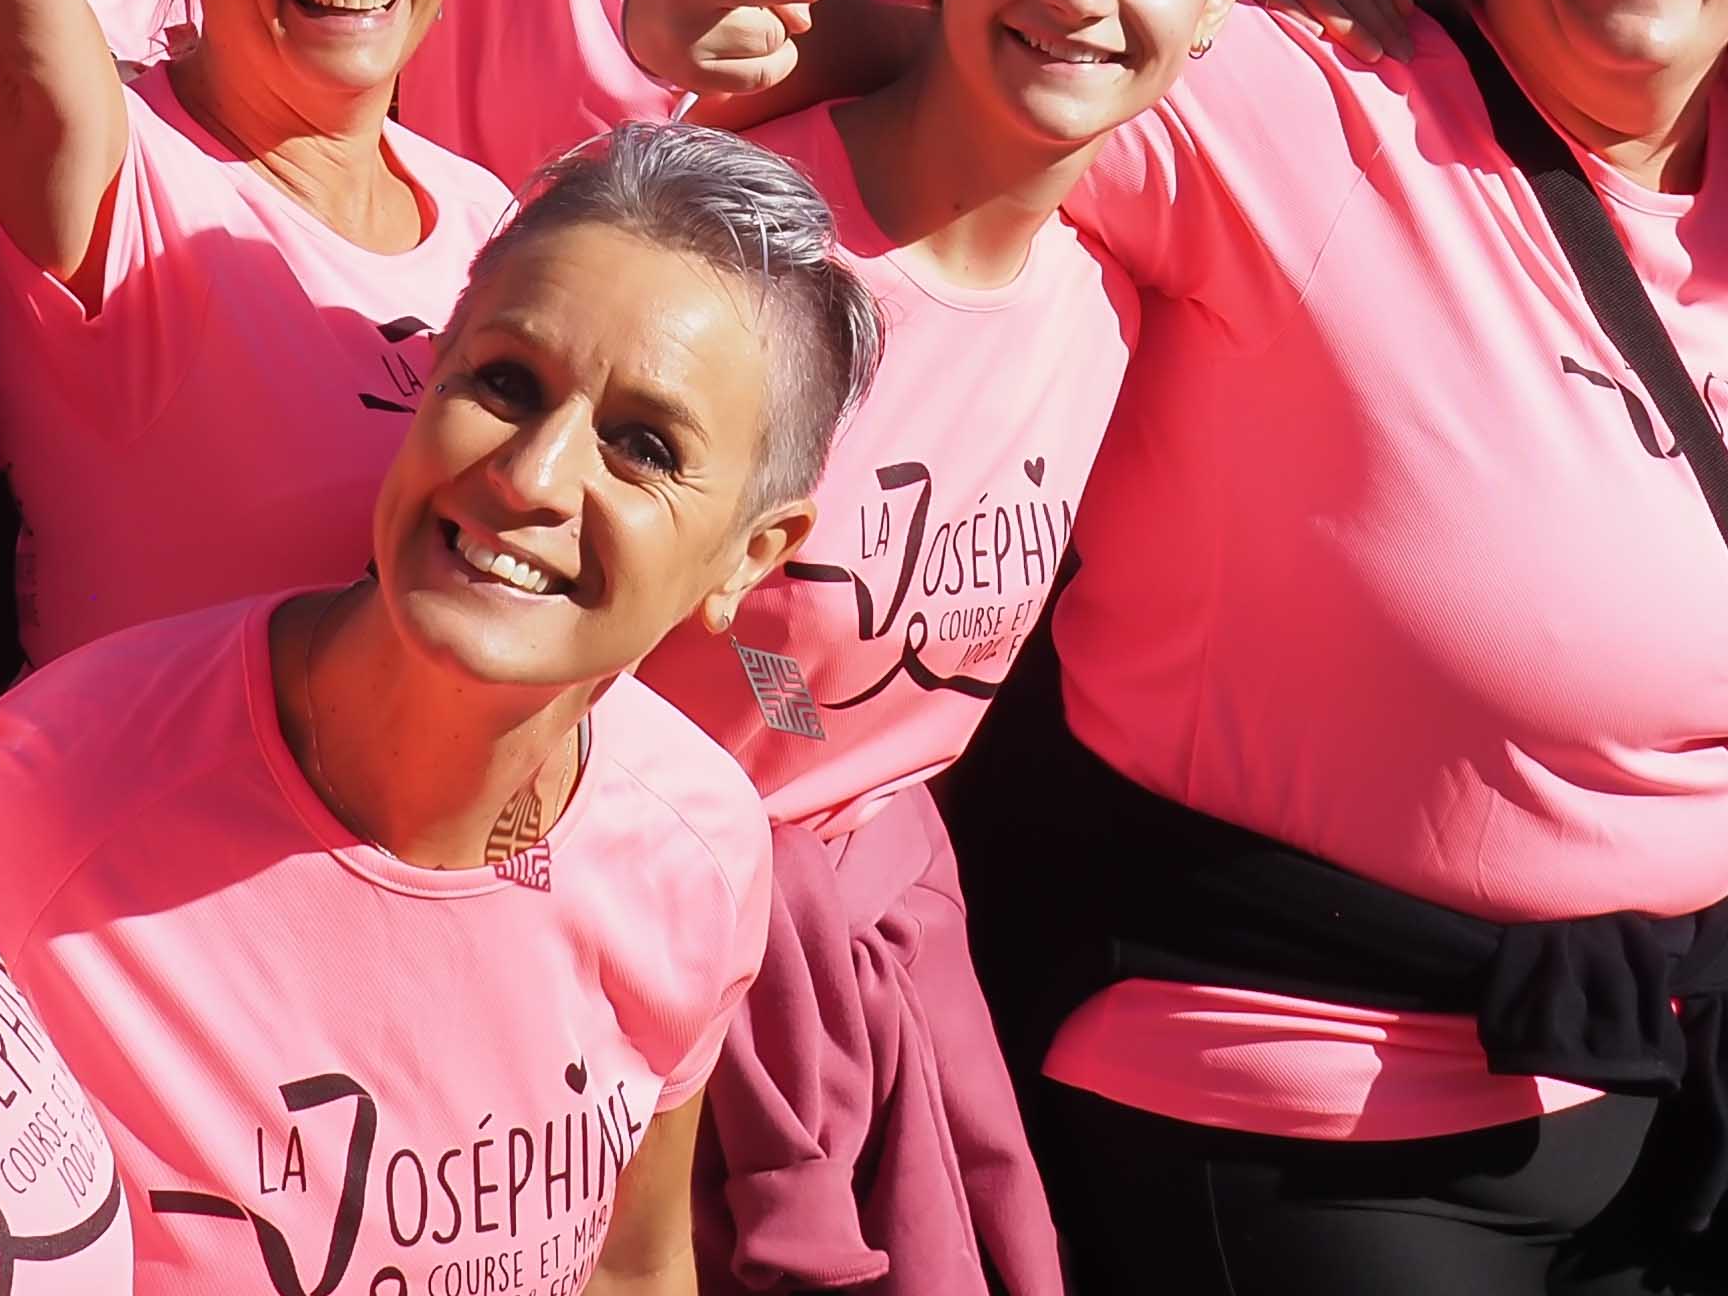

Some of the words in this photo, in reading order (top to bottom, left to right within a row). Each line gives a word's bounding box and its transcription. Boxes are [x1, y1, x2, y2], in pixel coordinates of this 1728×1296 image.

[381, 352, 425, 397] LA
[859, 501, 890, 561] LA
[939, 605, 1006, 641] COURSE
[1011, 599, 1034, 631] ET
[1, 1102, 68, 1193] COURSE
[256, 1125, 307, 1195] LA
[149, 1073, 643, 1296] JOSÉPHINE
[428, 1251, 524, 1296] COURSE
[540, 1234, 560, 1279] ET
